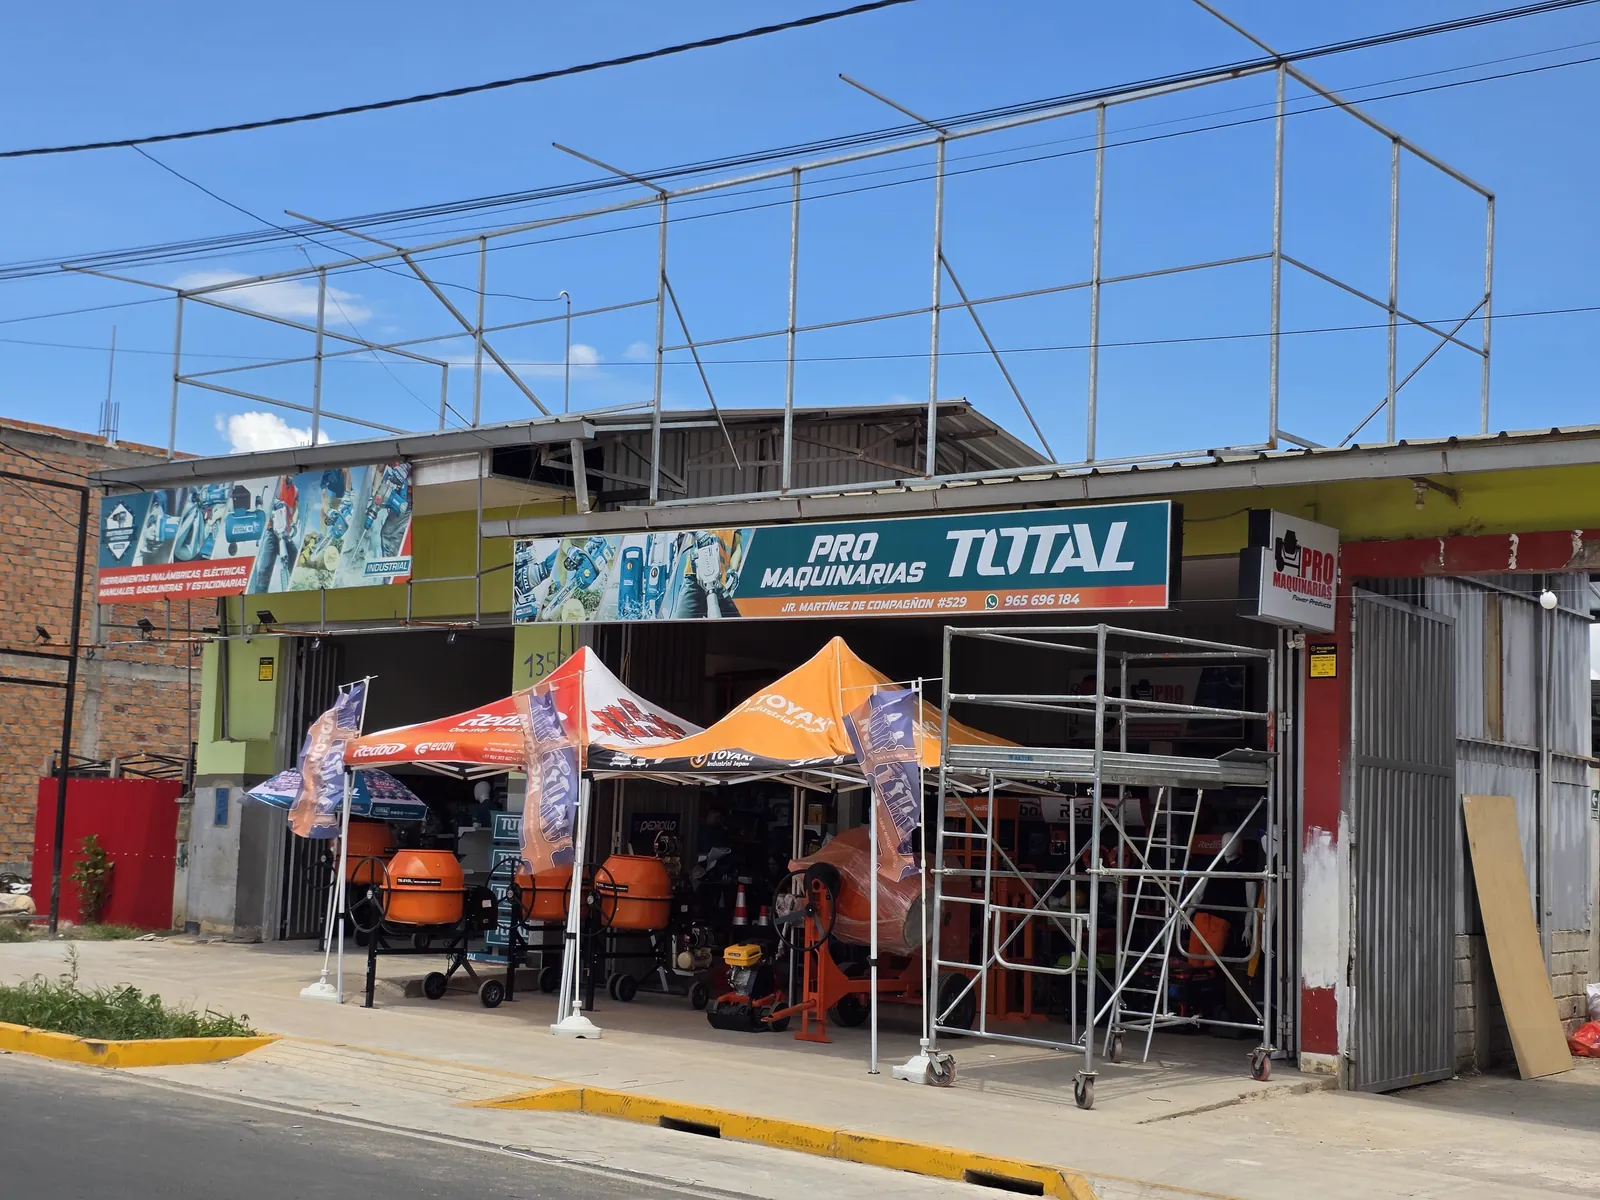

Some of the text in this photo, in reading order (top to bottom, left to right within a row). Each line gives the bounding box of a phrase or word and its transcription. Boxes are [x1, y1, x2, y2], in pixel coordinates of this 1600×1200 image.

[807, 532, 880, 564] PRO
[945, 520, 1135, 577] TOTAL
[366, 562, 408, 573] INDUSTRIAL
[1301, 547, 1334, 585] PRO
[100, 573, 151, 585] HERRAMIENTAS
[760, 561, 927, 591] MAQUINARIAS
[136, 583, 183, 595] GASOLINERAS
[186, 582, 192, 591] Y
[192, 578, 248, 590] ESTACIONARIAS
[1272, 572, 1333, 601] MAQUINARIAS
[781, 595, 968, 613] JR. MARTÍNEZ DE COMPAGÑON #529
[1004, 593, 1080, 607] 965 696 184
[1292, 594, 1332, 610] Power Products
[1155, 685, 1184, 703] PRO
